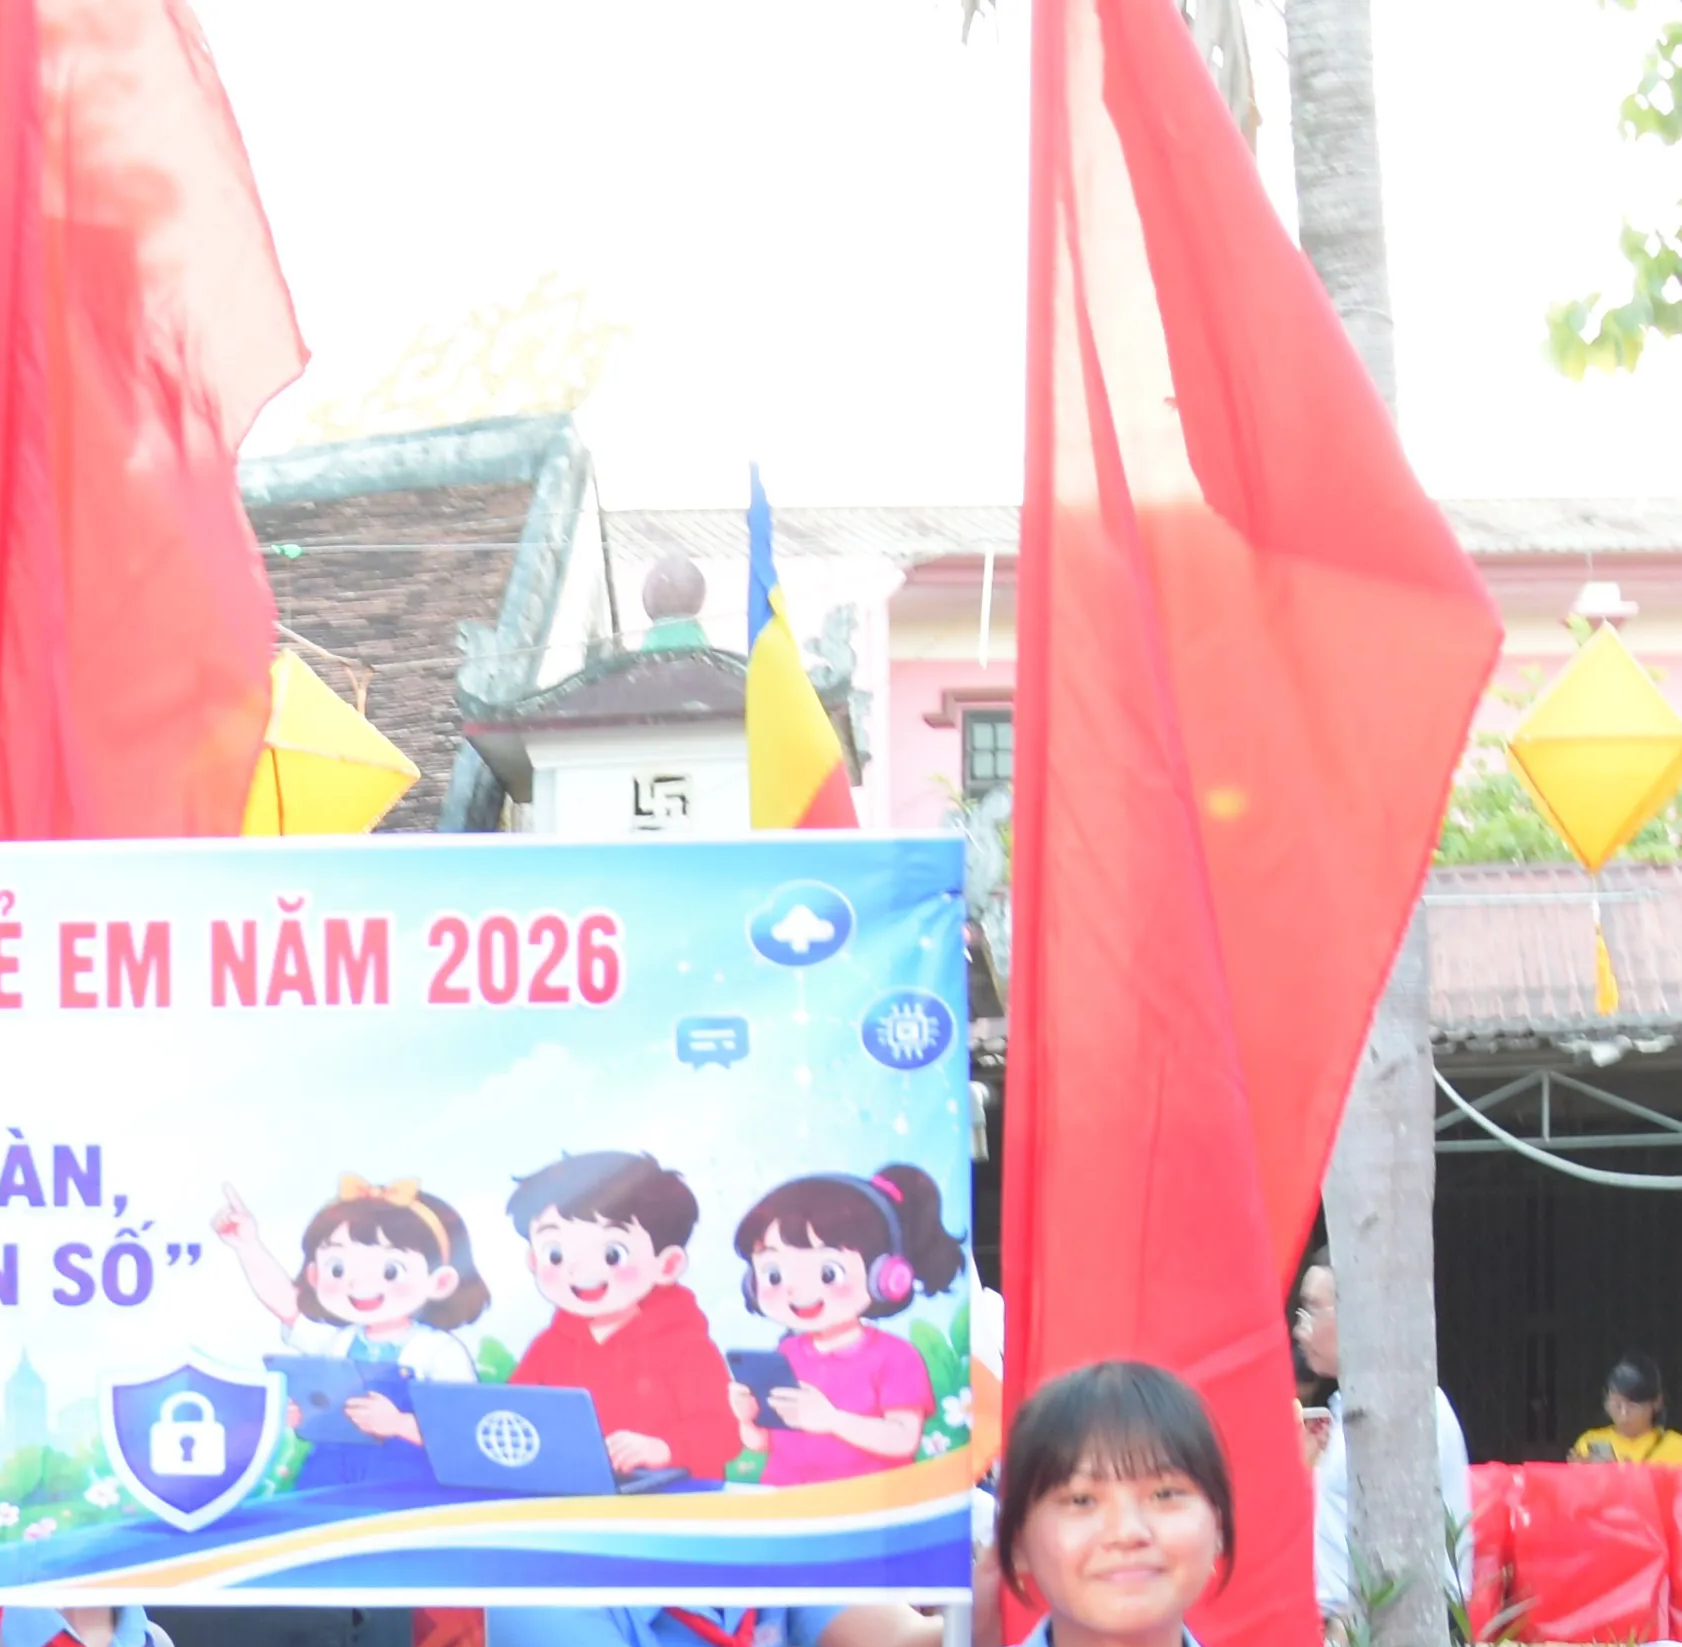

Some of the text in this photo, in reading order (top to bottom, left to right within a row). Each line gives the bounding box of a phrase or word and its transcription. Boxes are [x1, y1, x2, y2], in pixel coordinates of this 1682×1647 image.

[58, 920, 172, 1010] EM
[210, 896, 391, 1009] NĂM
[427, 913, 621, 1006] 2026
[51, 1219, 203, 1308] SỐ”
